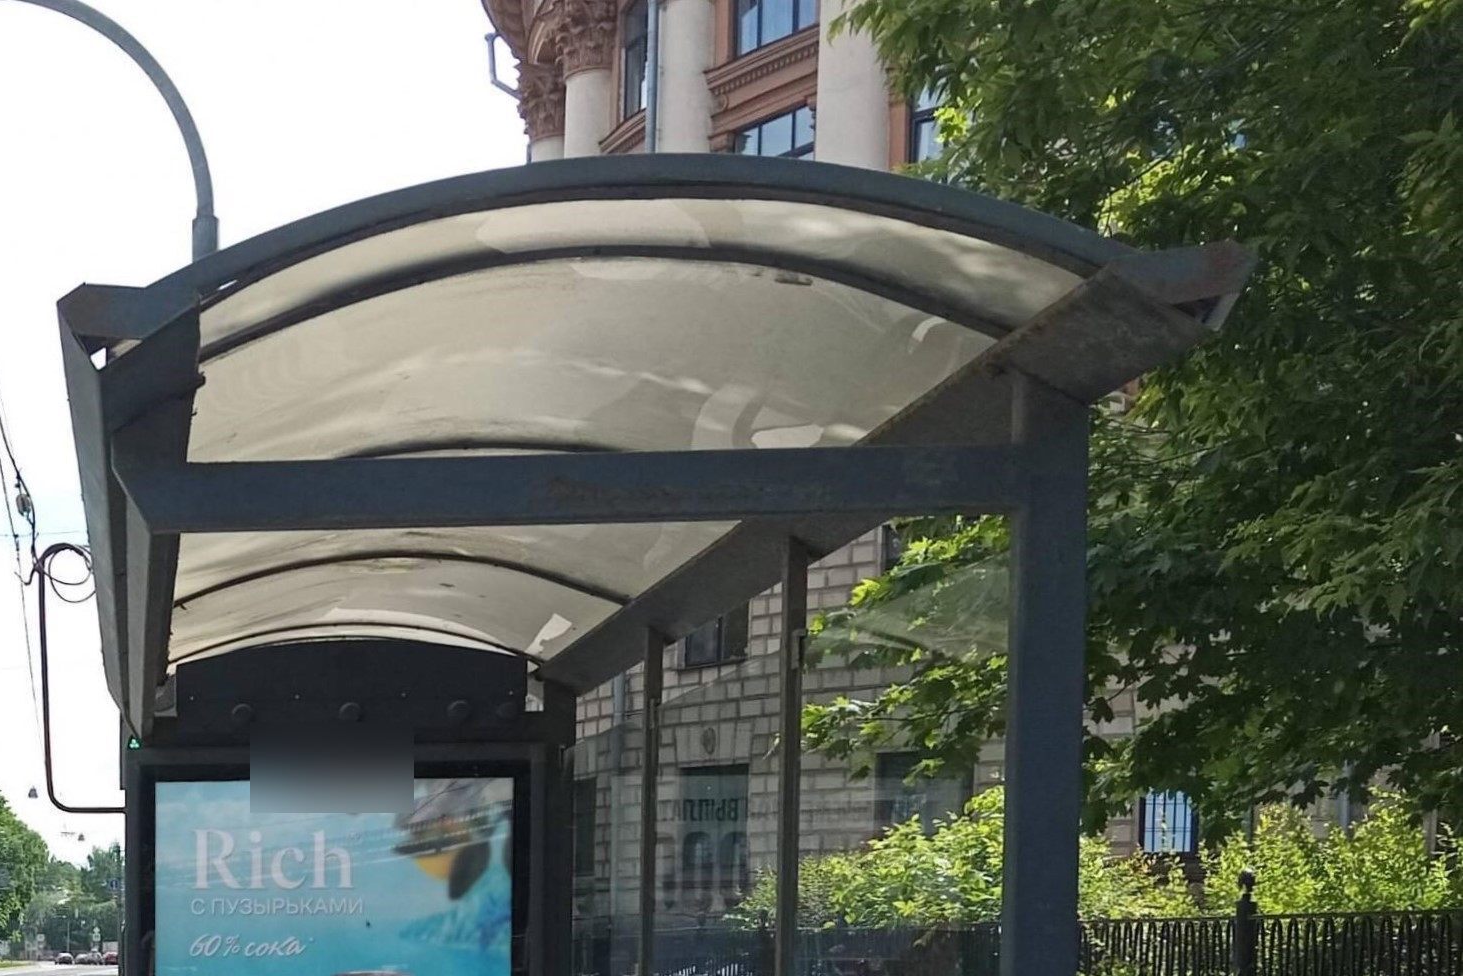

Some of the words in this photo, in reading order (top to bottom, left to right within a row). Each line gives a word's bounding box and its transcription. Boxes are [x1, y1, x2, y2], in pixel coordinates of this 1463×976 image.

[193, 828, 354, 889] Rich
[190, 898, 205, 915] С
[211, 898, 364, 915] ПУЗЫРЬКАМИ
[189, 934, 240, 957] 60%
